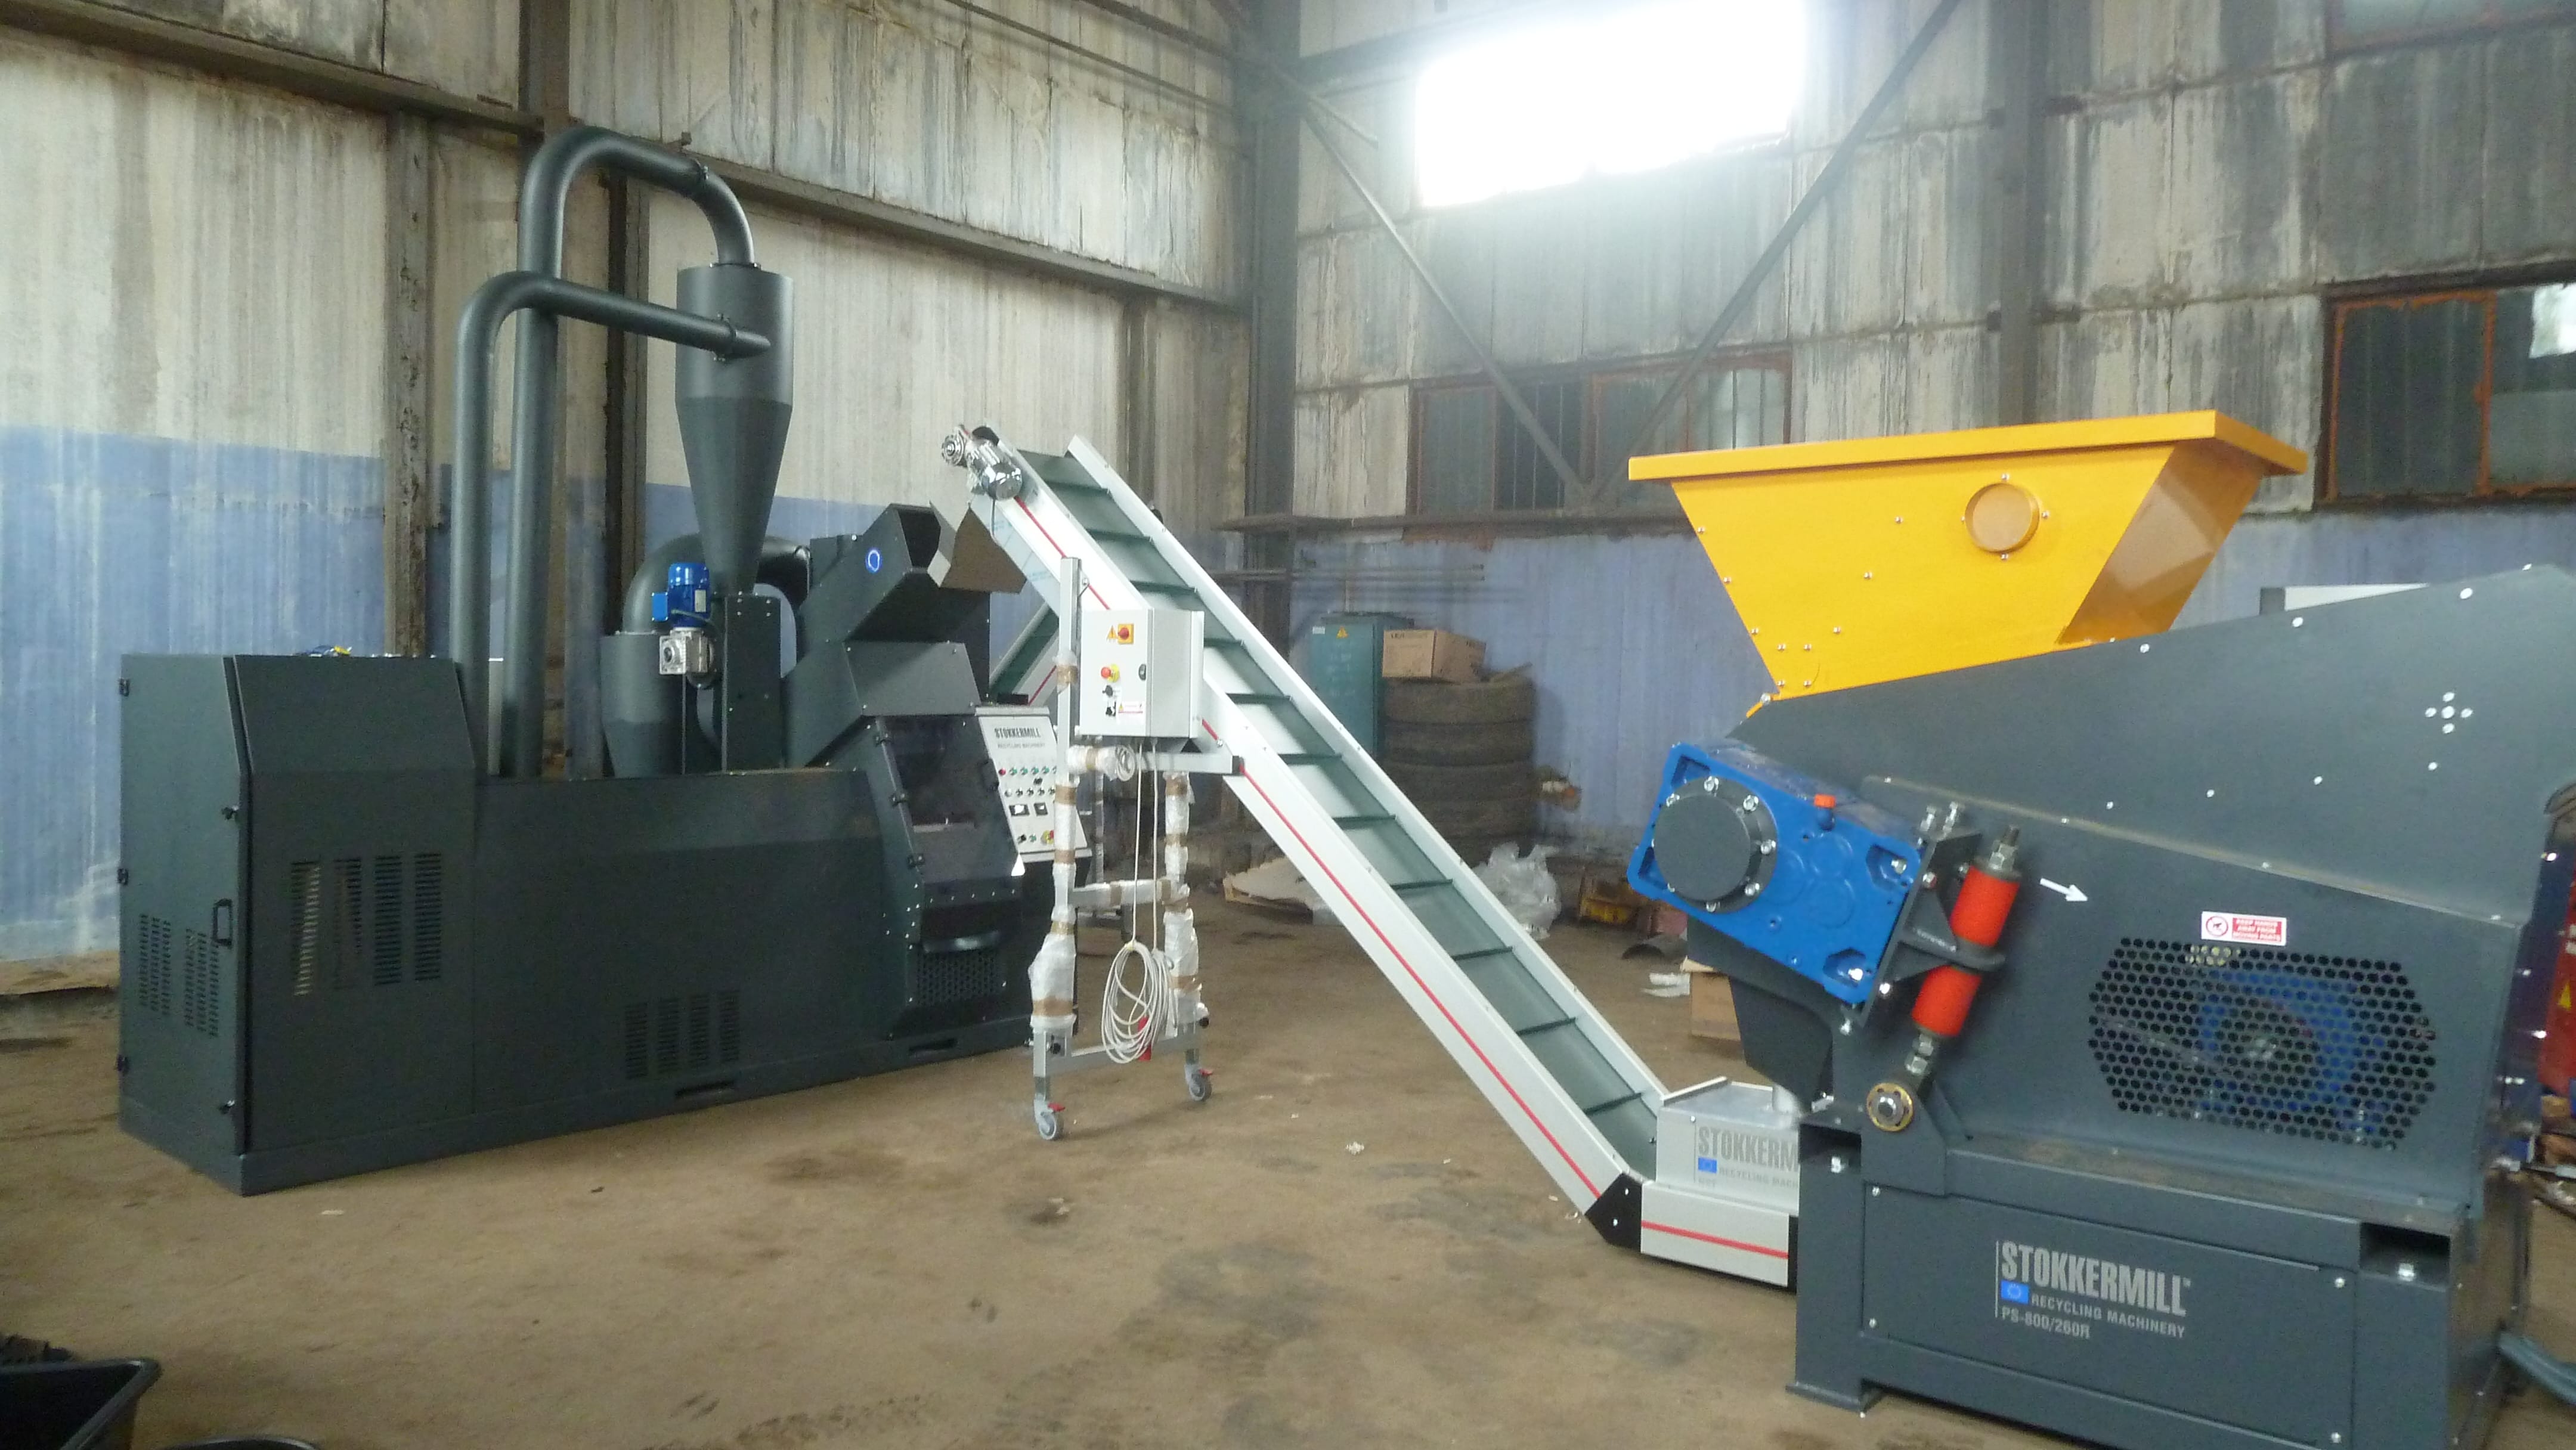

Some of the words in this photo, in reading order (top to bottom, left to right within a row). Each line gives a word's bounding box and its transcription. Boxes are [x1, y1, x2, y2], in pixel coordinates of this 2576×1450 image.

[994, 726, 1041, 739] STOKKERMILL
[1698, 1126, 1798, 1173] STOKKERM
[2002, 1240, 2187, 1317] STOKKERMILL
[2031, 1293, 2102, 1320] RECYCLING
[2107, 1310, 2185, 1339] MACHINERY
